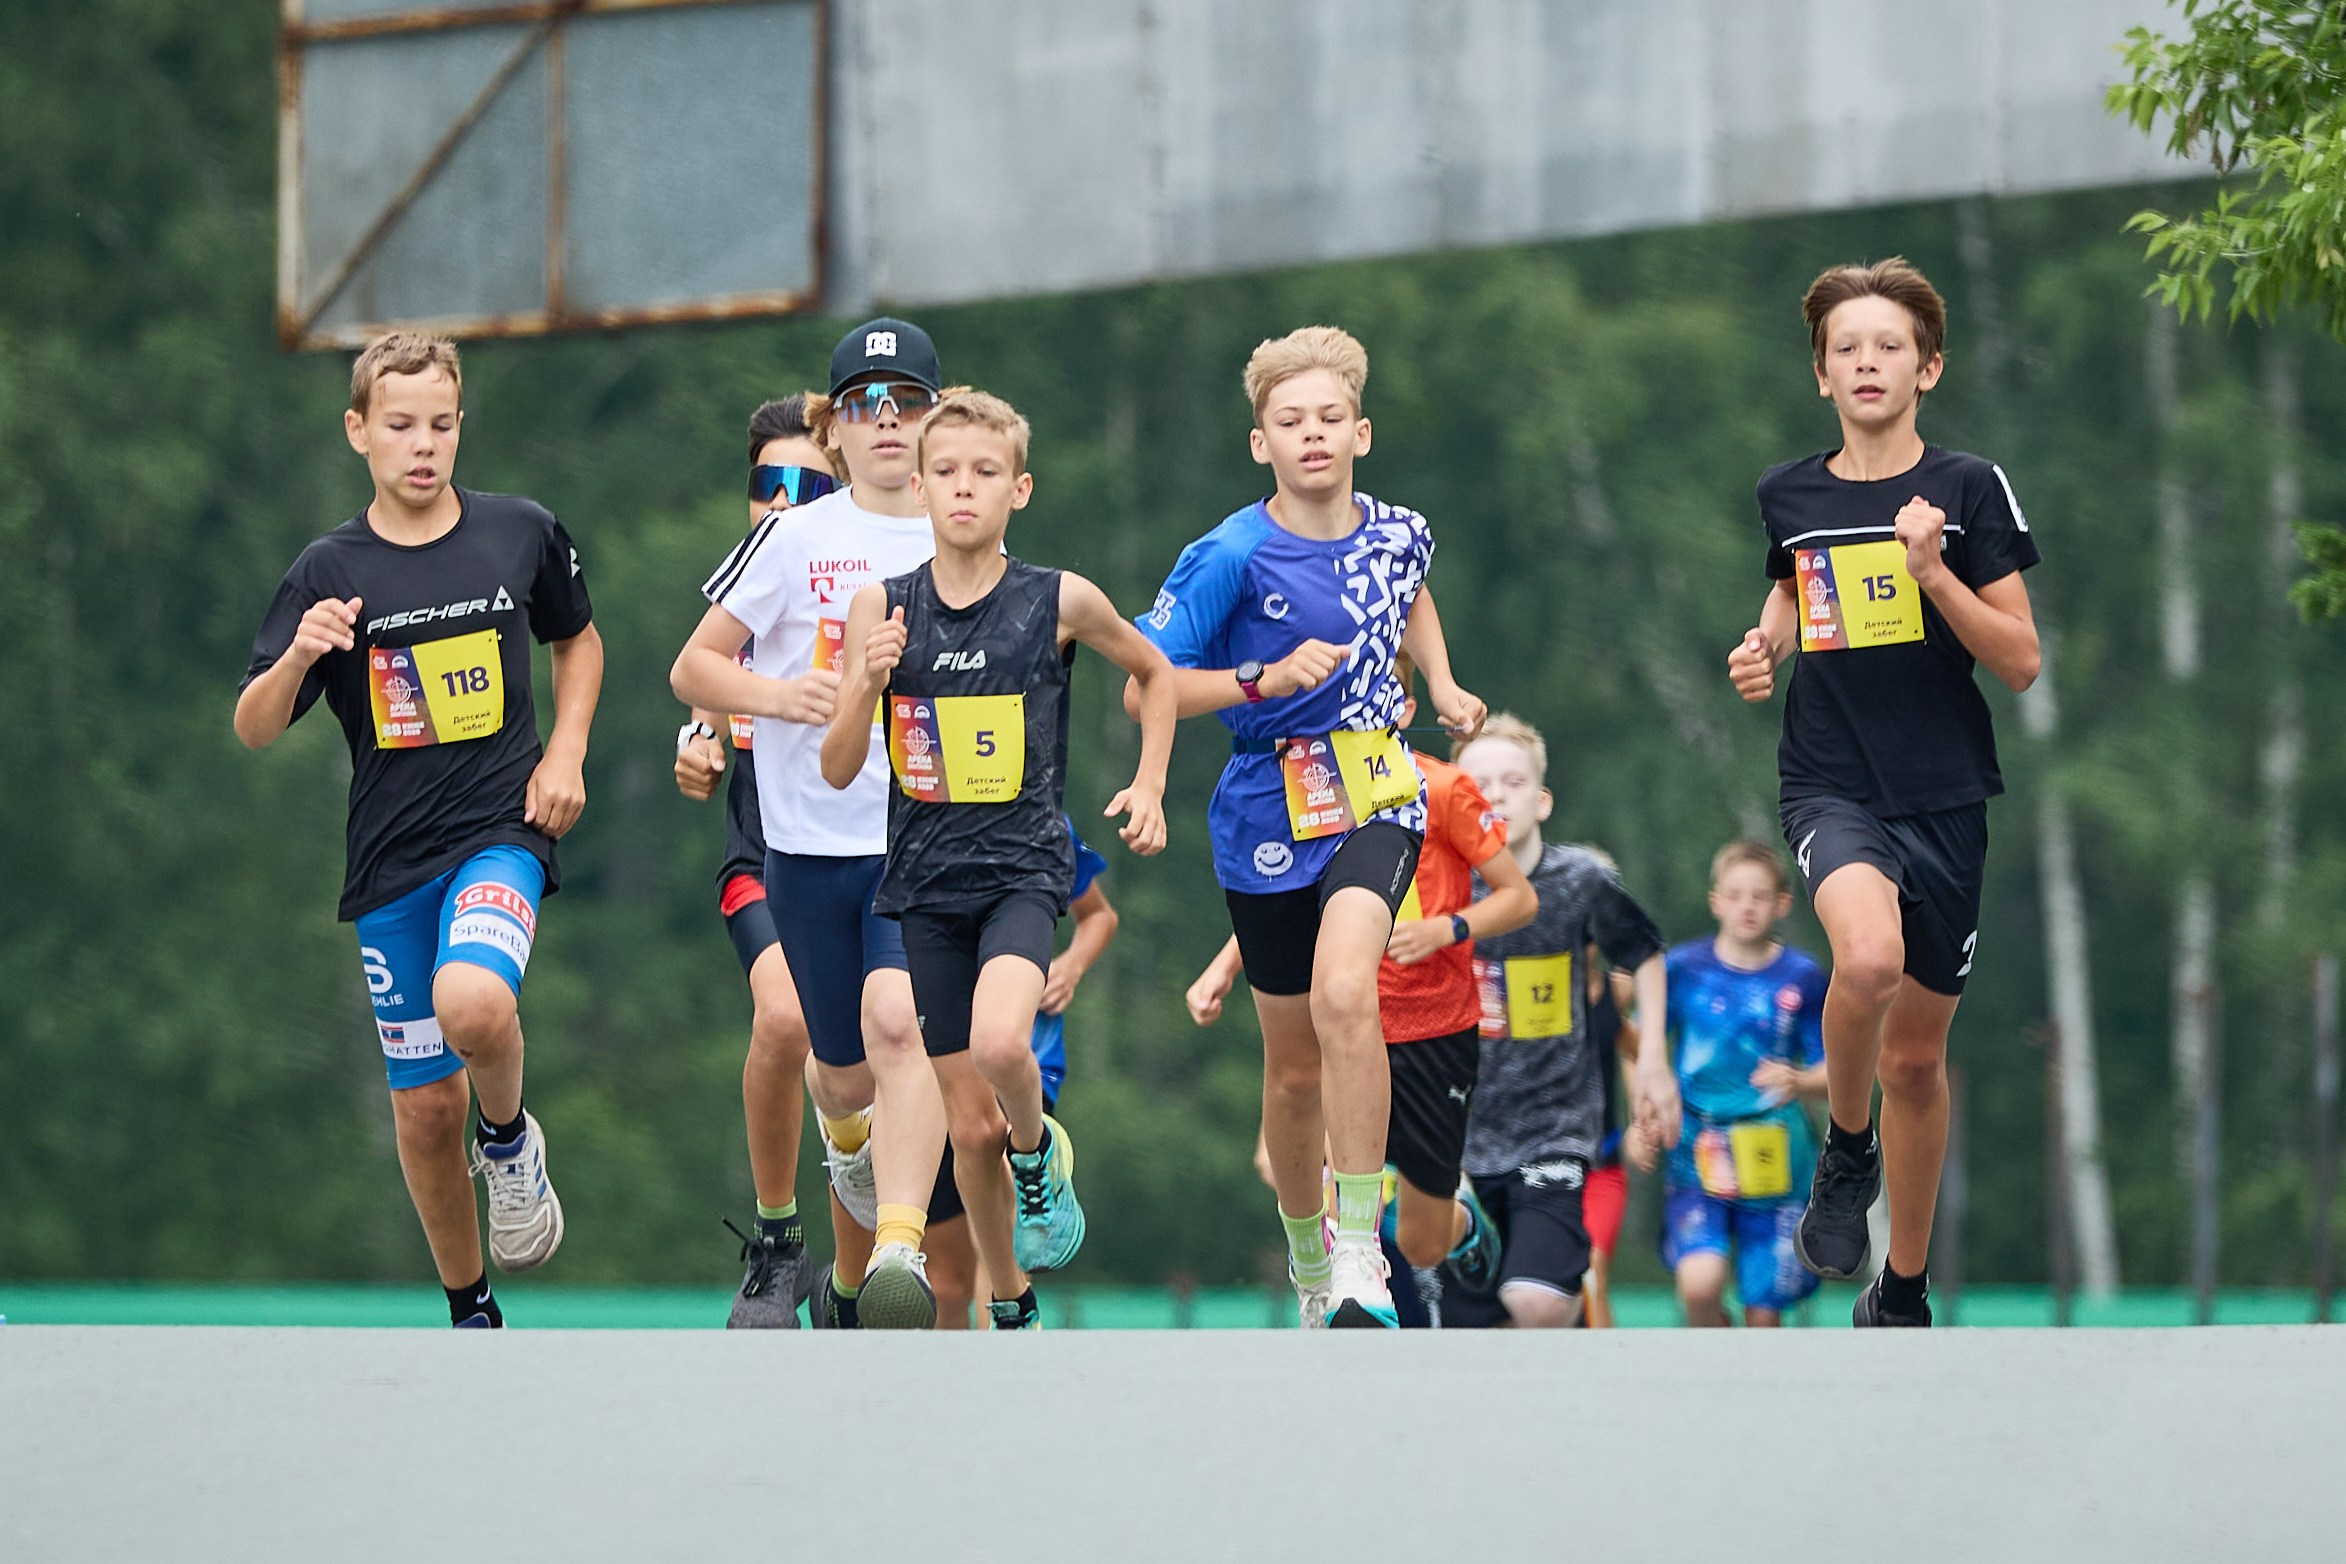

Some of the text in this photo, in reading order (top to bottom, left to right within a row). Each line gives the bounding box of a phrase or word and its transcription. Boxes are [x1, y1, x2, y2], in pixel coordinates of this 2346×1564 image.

[809, 559, 871, 574] LUKOIL
[1862, 574, 1896, 602] 15
[366, 599, 489, 635] FISCHER
[932, 649, 987, 672] FILA
[441, 666, 490, 697] 118
[453, 711, 491, 726] Детский
[976, 730, 996, 757] 5
[1363, 754, 1392, 782] 14
[966, 776, 1006, 786] Детский
[975, 787, 1000, 795] забег
[1531, 983, 1554, 1004] 12
